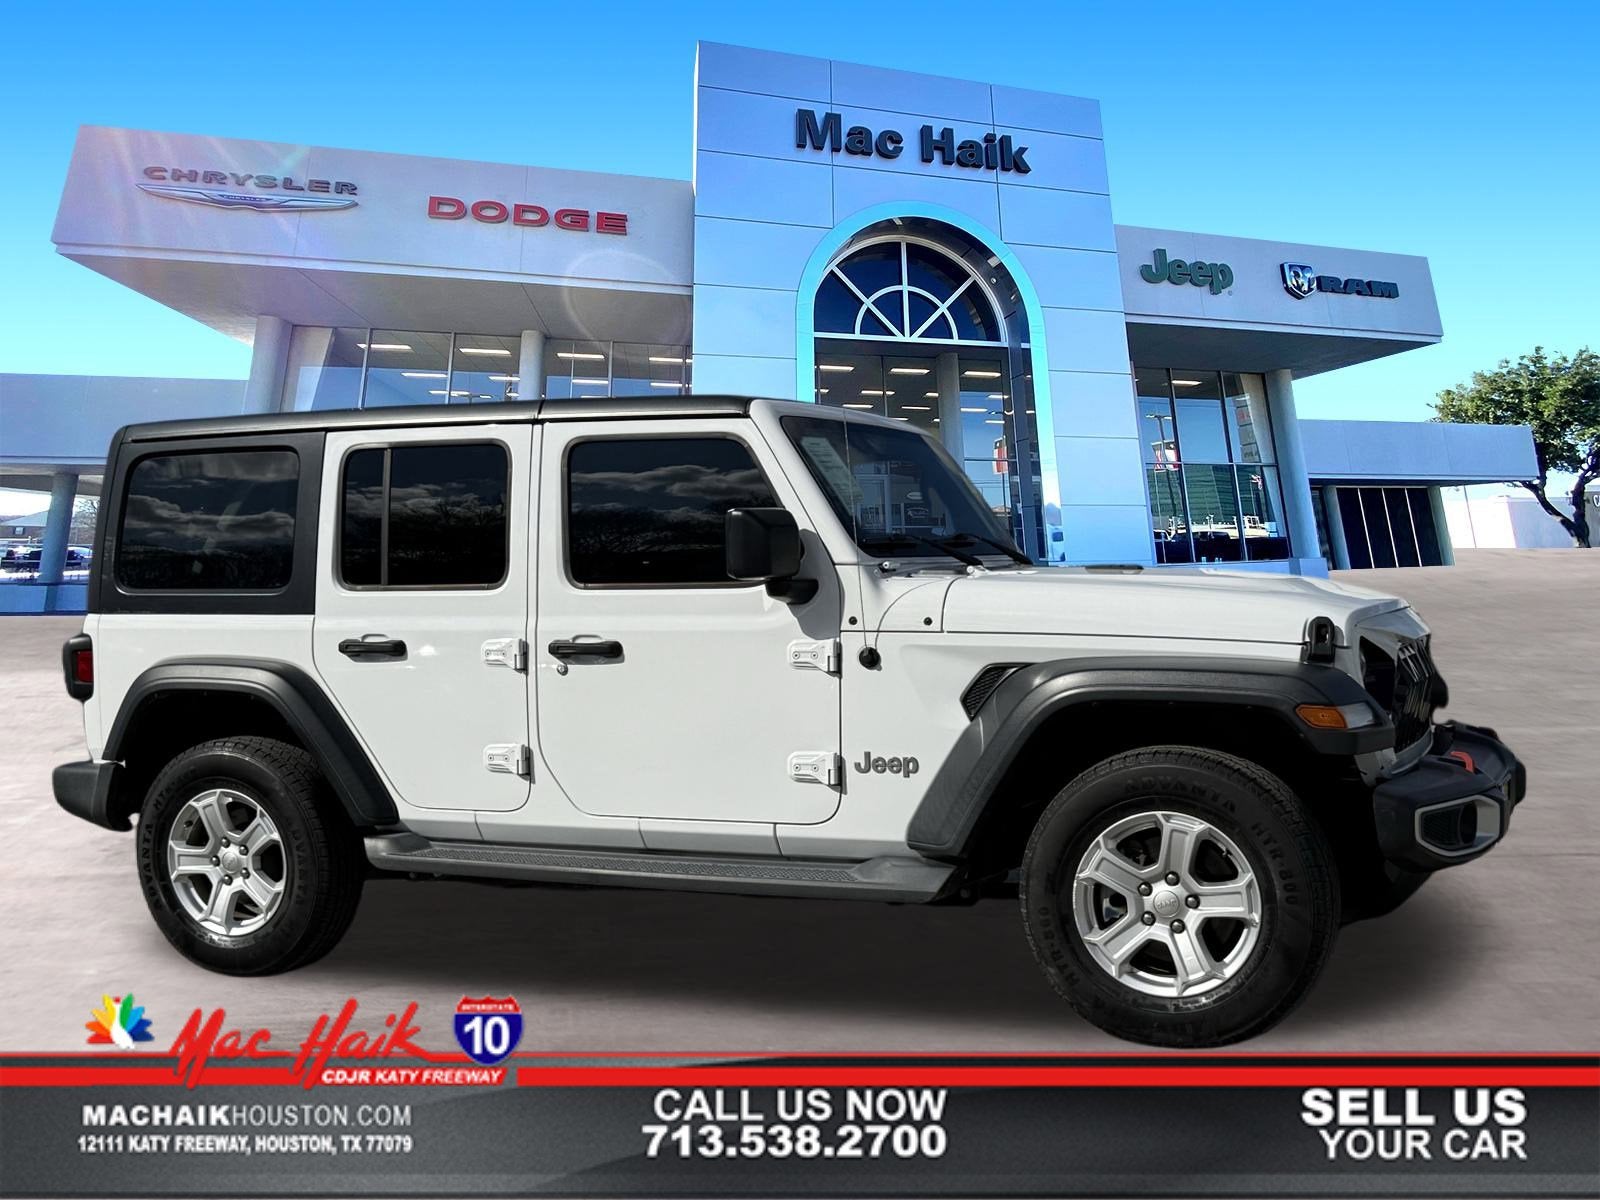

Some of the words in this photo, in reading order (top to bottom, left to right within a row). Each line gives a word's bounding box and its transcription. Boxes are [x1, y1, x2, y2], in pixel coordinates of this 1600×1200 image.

[795, 108, 903, 159] Mac
[919, 124, 1032, 174] Haik
[143, 165, 359, 196] CHRYSLER
[427, 195, 629, 236] DODGE
[1140, 248, 1234, 295] Jeep
[1316, 275, 1399, 300] RAM
[854, 751, 920, 778] Jeep
